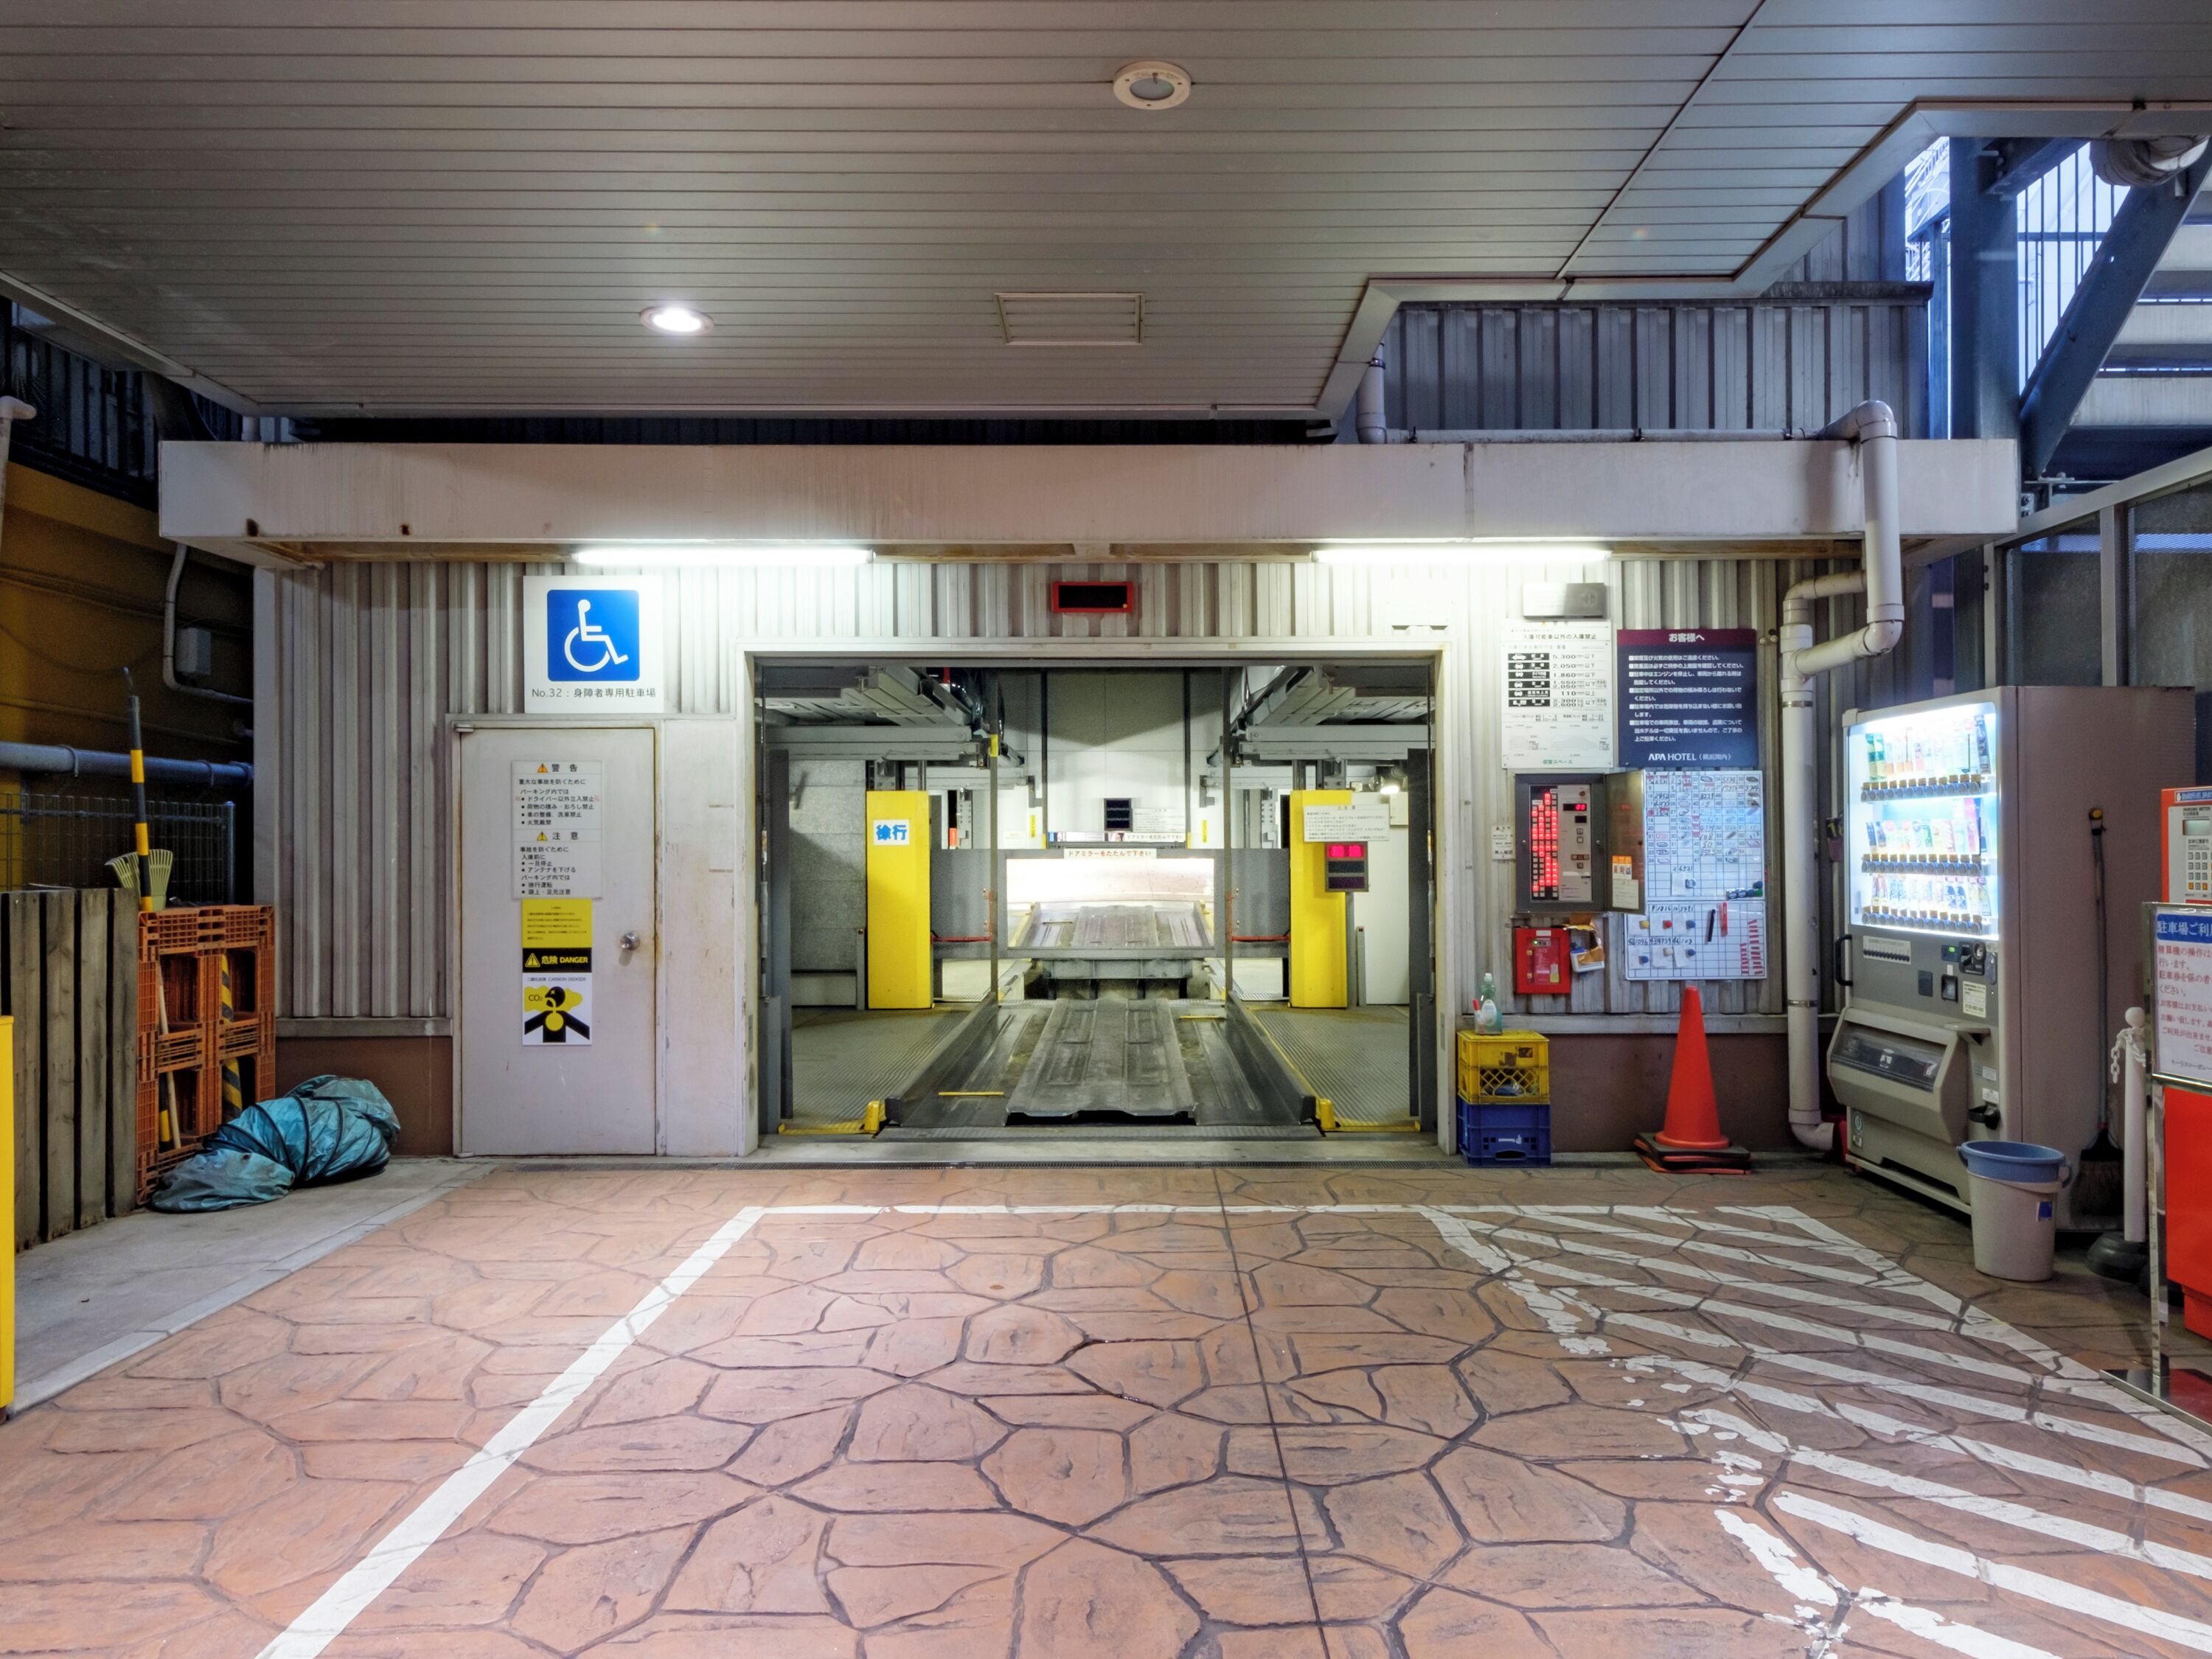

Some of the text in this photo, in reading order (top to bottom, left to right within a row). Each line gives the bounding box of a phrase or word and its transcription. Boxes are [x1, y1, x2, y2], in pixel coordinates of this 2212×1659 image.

[1669, 633, 1705, 642] お客様へ
[1649, 753, 1666, 761] APA
[1668, 753, 1697, 761] HOTEL
[552, 832, 578, 840] 注意
[876, 824, 908, 841] 徐行
[2158, 945, 2212, 959] 精算機の操作は
[541, 956, 558, 964] 危険
[2159, 959, 2189, 970] 行います。
[2159, 970, 2212, 984] 駐車券を係の者
[2159, 985, 2187, 997] ください。
[2162, 1026, 2212, 1041] ご利用が出来ませ
